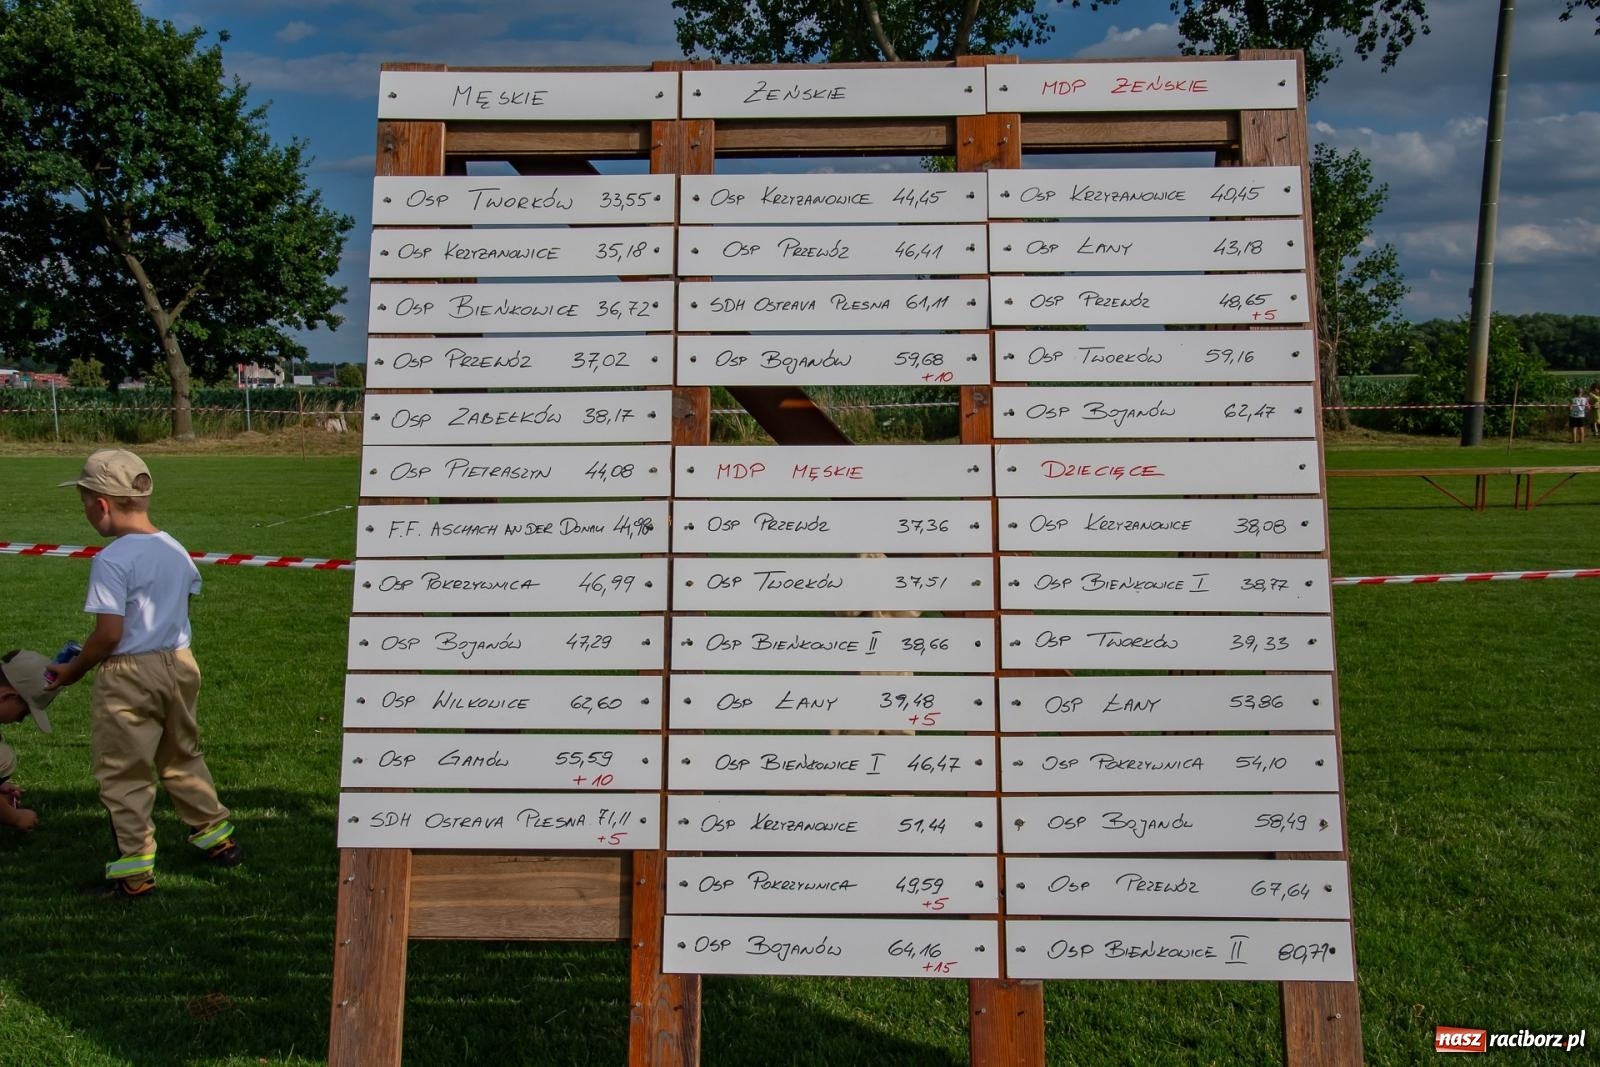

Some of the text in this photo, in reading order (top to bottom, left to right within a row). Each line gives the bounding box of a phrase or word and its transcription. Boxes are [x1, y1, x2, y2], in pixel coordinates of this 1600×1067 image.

[1043, 79, 1086, 95] MDP
[453, 85, 548, 109] MĘSKIE
[600, 192, 652, 211] 33,55
[892, 188, 947, 208] 44,45
[1210, 184, 1264, 203] 40,45
[596, 241, 647, 262] 35,18
[895, 241, 943, 260] 46,41
[1077, 236, 1133, 256] ŁANY
[1213, 238, 1263, 256] 43,18
[596, 301, 650, 319] 36,72
[710, 294, 950, 312] SDH OSTRAVA PLESNA 61,11
[1219, 293, 1272, 311] 48,65
[571, 352, 630, 373] 37,02
[894, 352, 944, 368] 59,68
[1205, 349, 1254, 364] 59,16
[448, 404, 561, 426] ZABEŁKÓW
[583, 408, 635, 425] 38,17
[1224, 403, 1275, 422] 62,47
[445, 458, 551, 480] PIETRASZYN
[585, 461, 634, 483] 44,08
[717, 463, 862, 481] MDP MĘSKIE
[1041, 460, 1165, 479] DZIECIĘCE
[431, 521, 498, 536] ASCHACH
[560, 517, 605, 535] DONAU
[897, 519, 948, 535] 37,36
[1234, 518, 1286, 536] 38,08
[578, 572, 635, 597] 46,99
[896, 576, 947, 589] 37,51
[1241, 578, 1288, 592] 38,77
[566, 633, 612, 652] 47,29
[902, 638, 949, 656] 38,66
[432, 690, 530, 709] WILKOWICE
[571, 695, 622, 715] 62,60
[775, 691, 838, 711] ŁANY
[880, 692, 934, 711] 39,48
[1102, 693, 1161, 713] ŁANY
[438, 749, 508, 767] GAMÓW
[555, 751, 613, 768] 55,59
[907, 754, 961, 774] 46,47
[1236, 755, 1287, 772] 54,10
[370, 808, 631, 829] SDH OSTRAVA PLESNA 71,11
[898, 818, 945, 834] 51,44
[1255, 812, 1307, 832] 58,49
[896, 876, 943, 894] 49,59
[1251, 880, 1310, 901] 67,64
[888, 940, 941, 959] 64,16
